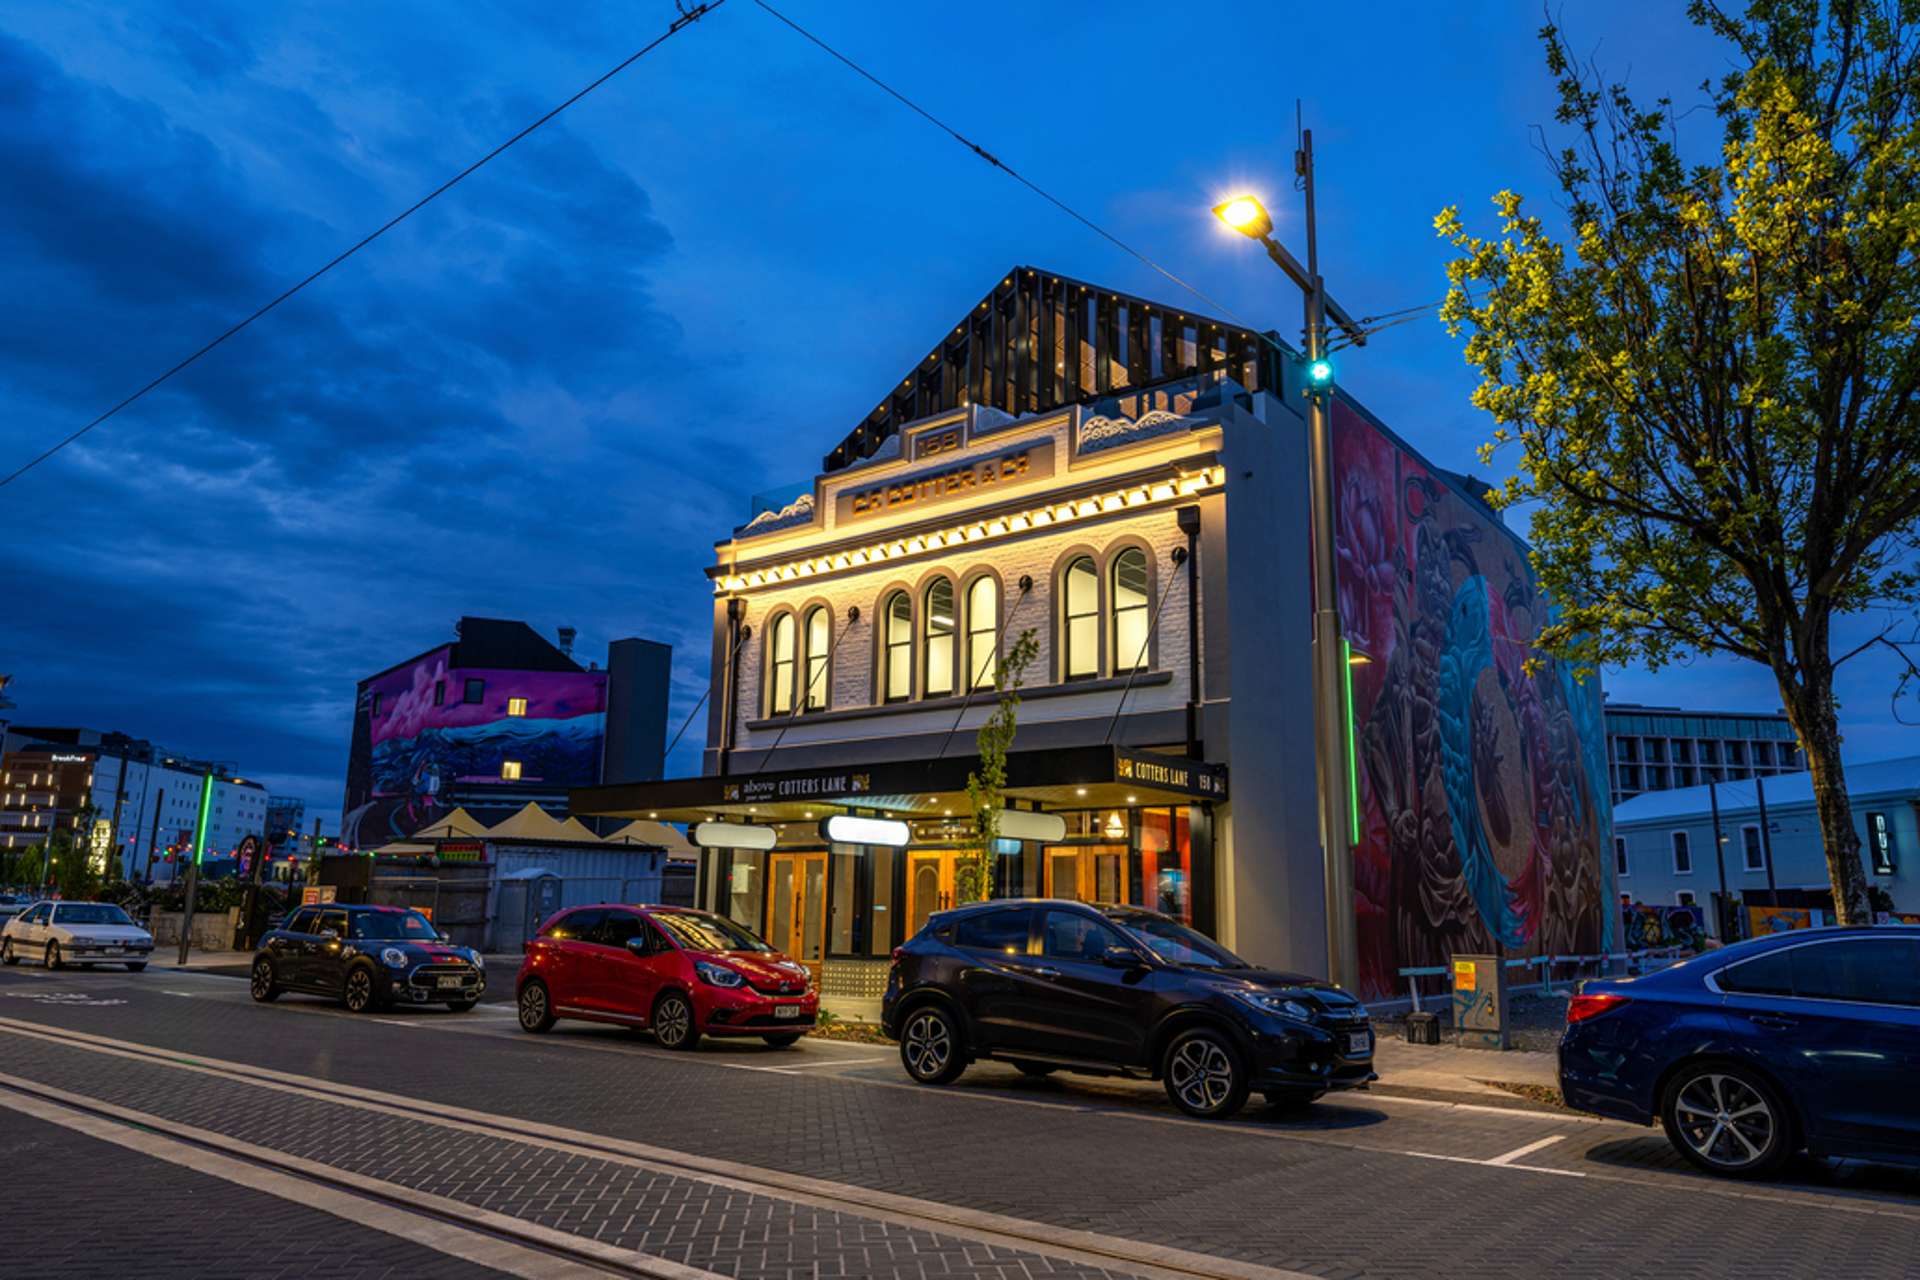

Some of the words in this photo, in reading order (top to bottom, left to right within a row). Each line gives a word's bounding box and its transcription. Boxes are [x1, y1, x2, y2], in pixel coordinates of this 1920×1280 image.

[886, 466, 976, 508] COTTER
[981, 462, 996, 484] &
[1136, 762, 1168, 783] COTTERS
[1170, 768, 1188, 787] LANE
[743, 780, 776, 793] above
[778, 778, 818, 796] COTTERS
[821, 776, 846, 793] LANE
